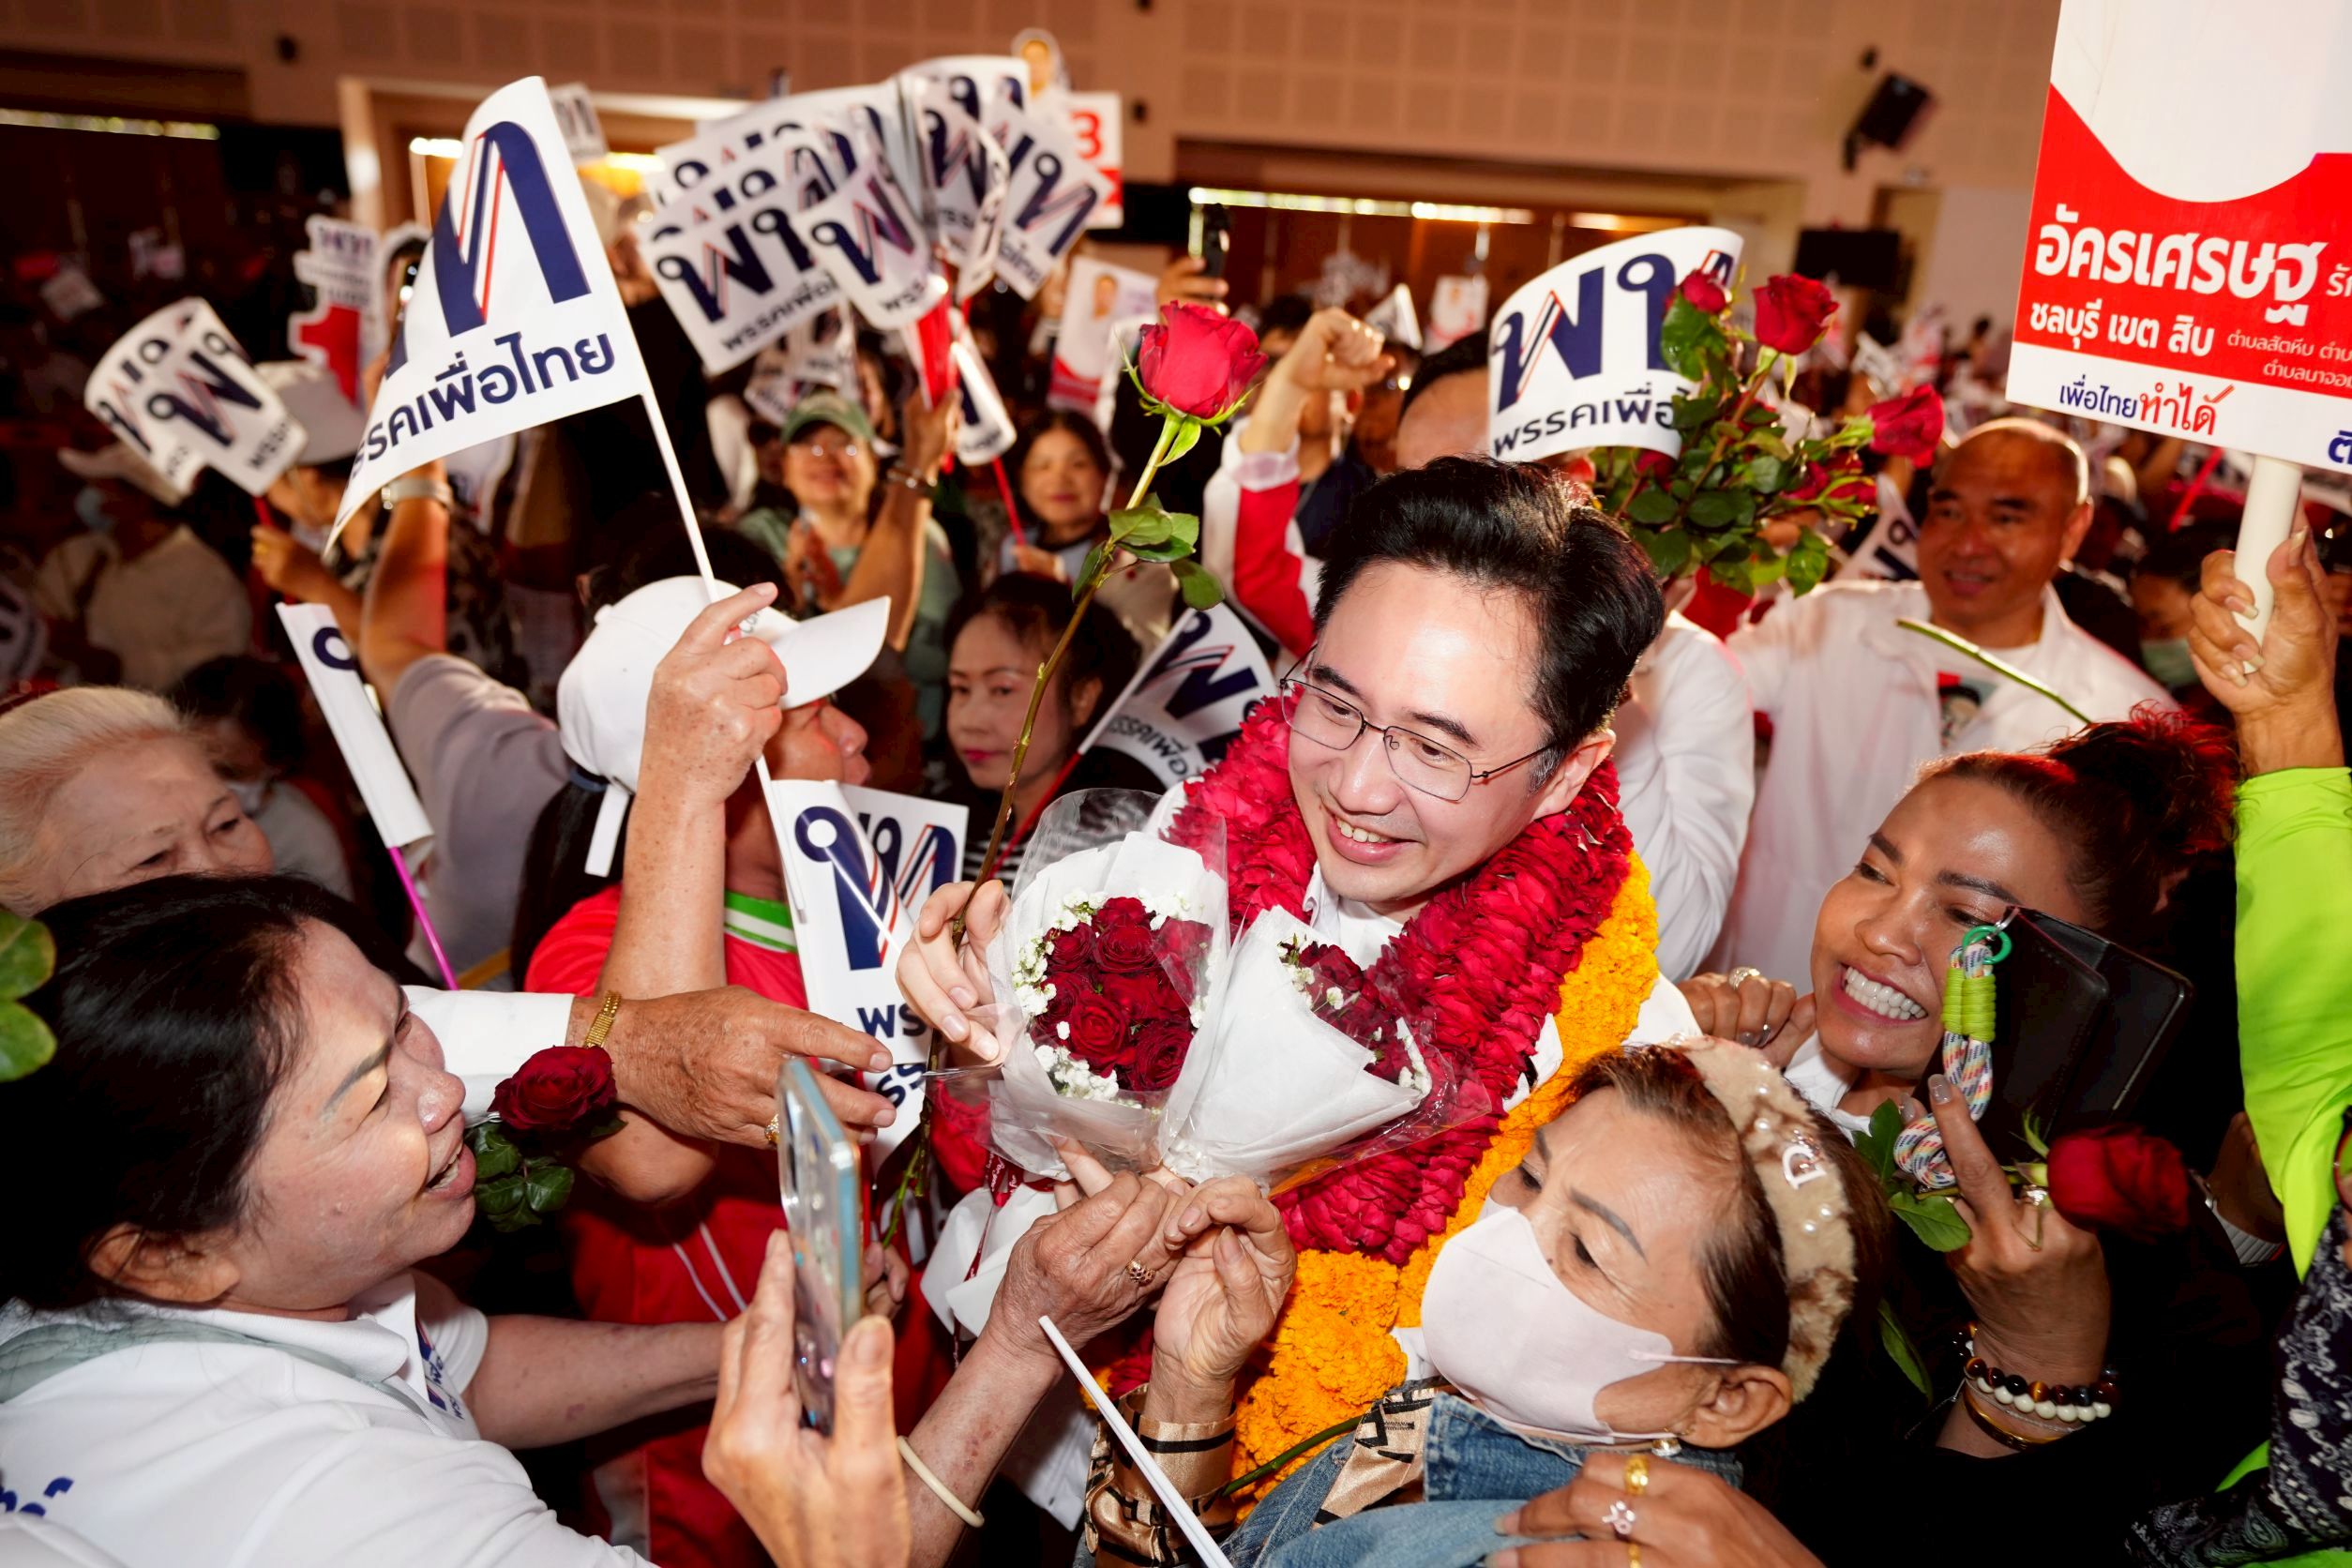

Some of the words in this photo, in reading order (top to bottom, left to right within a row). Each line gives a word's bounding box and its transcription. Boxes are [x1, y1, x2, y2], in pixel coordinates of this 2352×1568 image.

[2034, 204, 2329, 326] อัครเศรษฐ
[2326, 264, 2352, 297] รั
[2029, 298, 2103, 350] ชลบุรี
[2107, 313, 2160, 349] เขต
[2167, 314, 2215, 357] สิบ
